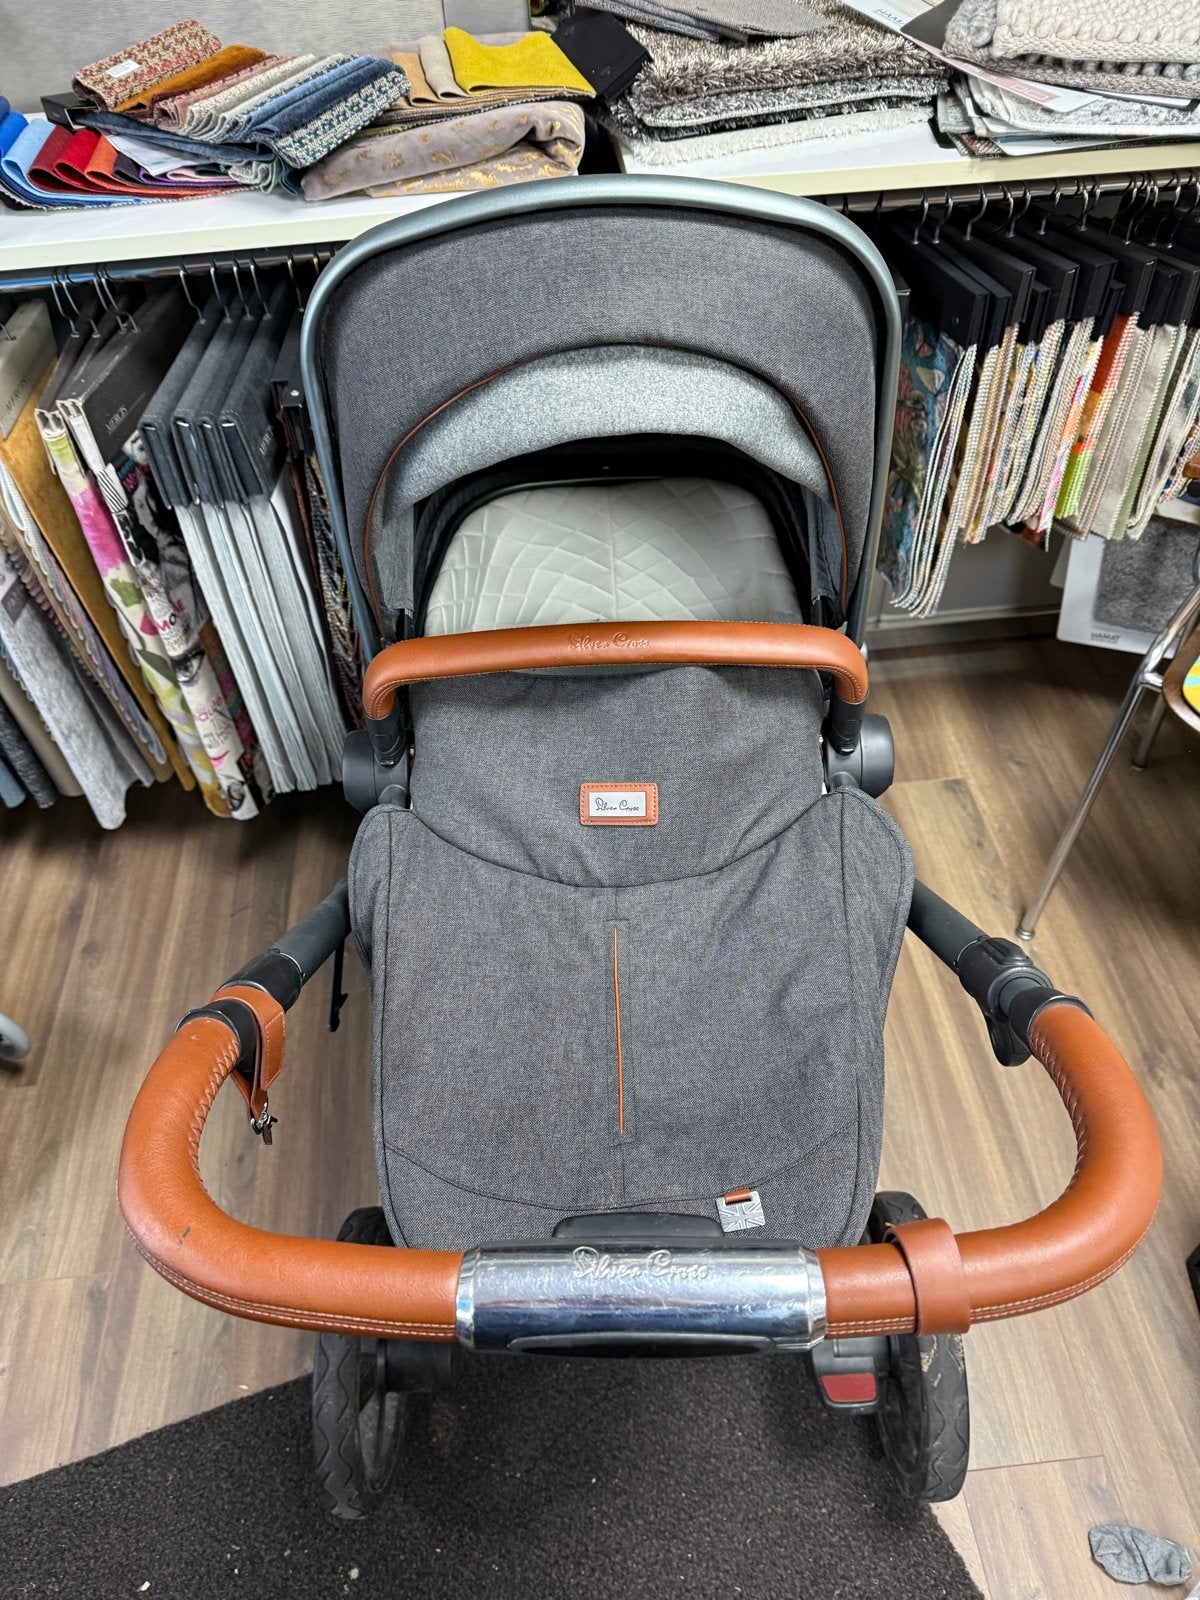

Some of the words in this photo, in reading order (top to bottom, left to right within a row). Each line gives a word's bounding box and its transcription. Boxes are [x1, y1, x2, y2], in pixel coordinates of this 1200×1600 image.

[568, 632, 610, 651] Silver
[613, 631, 650, 648] Cross
[595, 797, 617, 811] Silver
[619, 799, 640, 811] Cross
[572, 1246, 641, 1279] Silver
[646, 1249, 708, 1279] Cross
